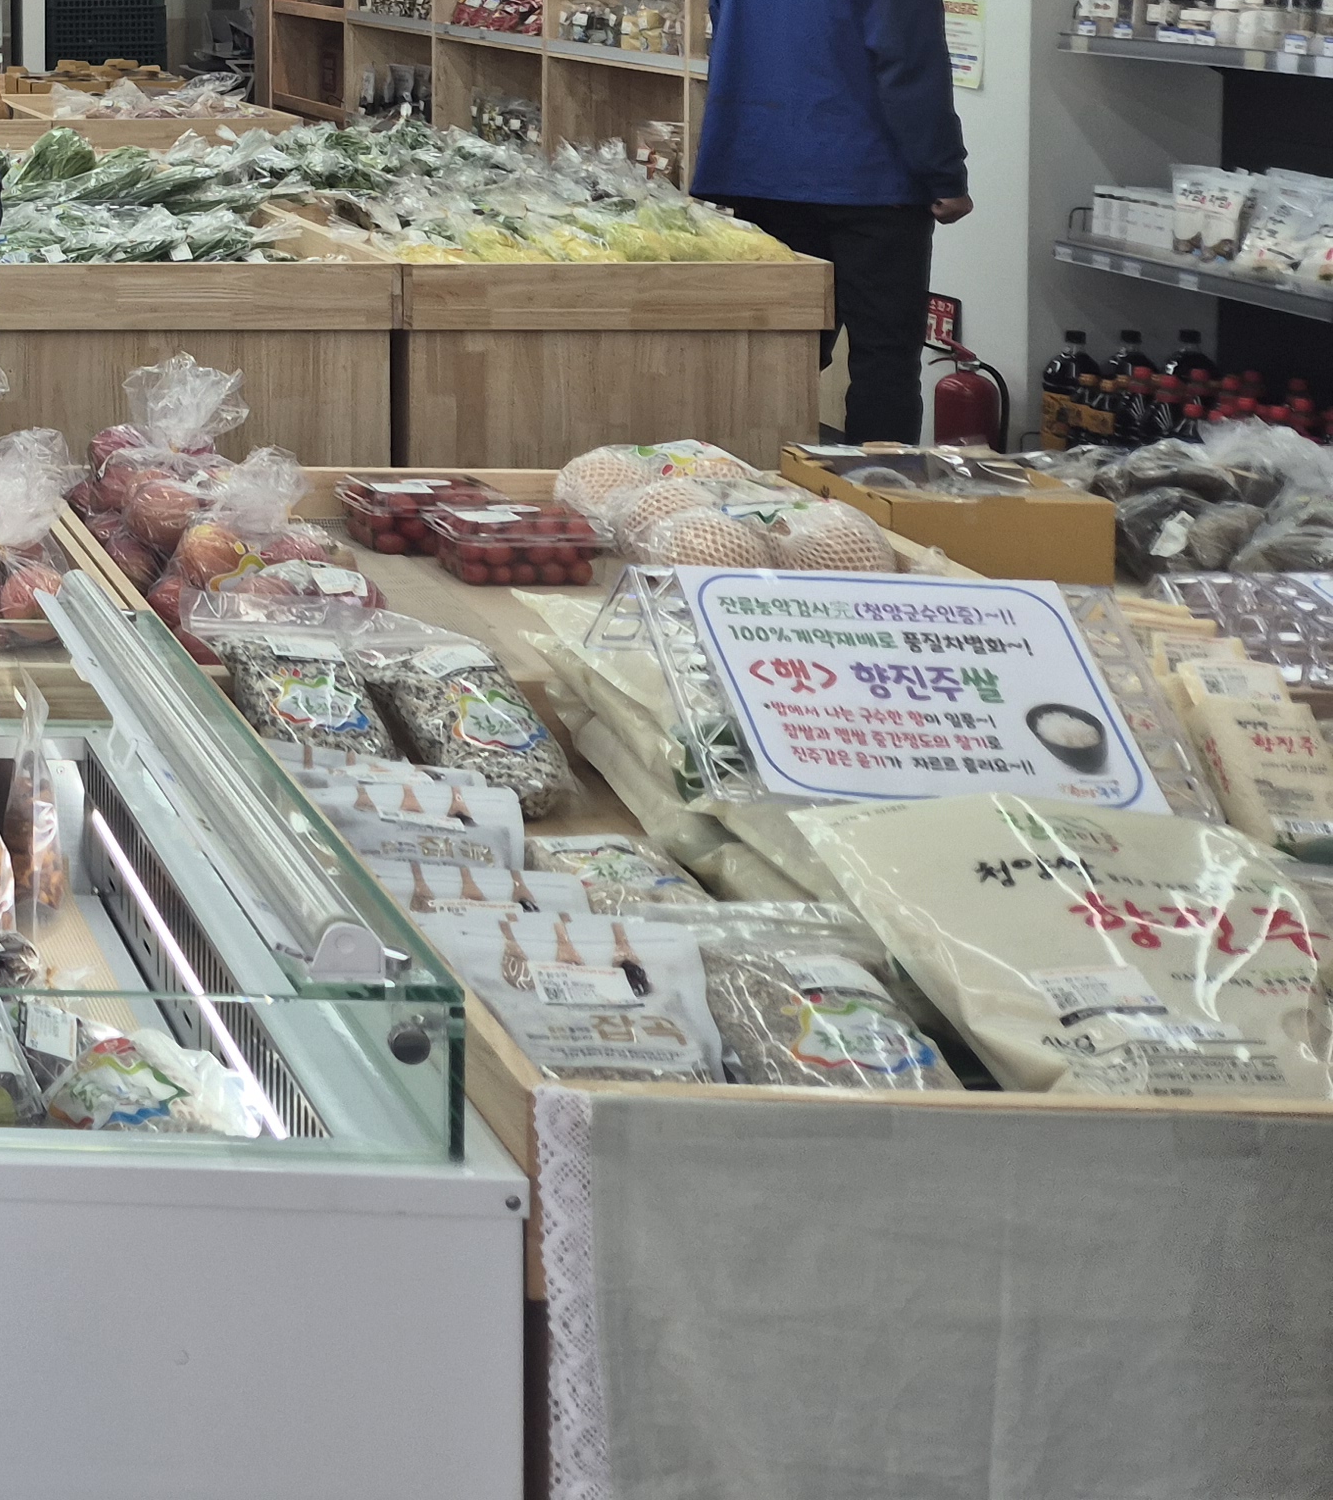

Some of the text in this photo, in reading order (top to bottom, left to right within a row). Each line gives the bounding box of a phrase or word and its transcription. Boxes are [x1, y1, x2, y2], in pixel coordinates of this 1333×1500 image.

[929, 298, 954, 315] 소화기
[727, 624, 1035, 657] 100%계약재배로 품질차별화~!
[849, 661, 1006, 704] 향진주쌀
[824, 706, 856, 723] 나는
[858, 707, 904, 726] 구수한
[906, 709, 942, 727] 향이
[782, 722, 832, 742] 찹쌀과
[871, 729, 952, 750] 중간정도의
[953, 733, 1005, 751] 찰기로
[789, 744, 853, 768] 진주같은
[910, 754, 961, 773] 자르르
